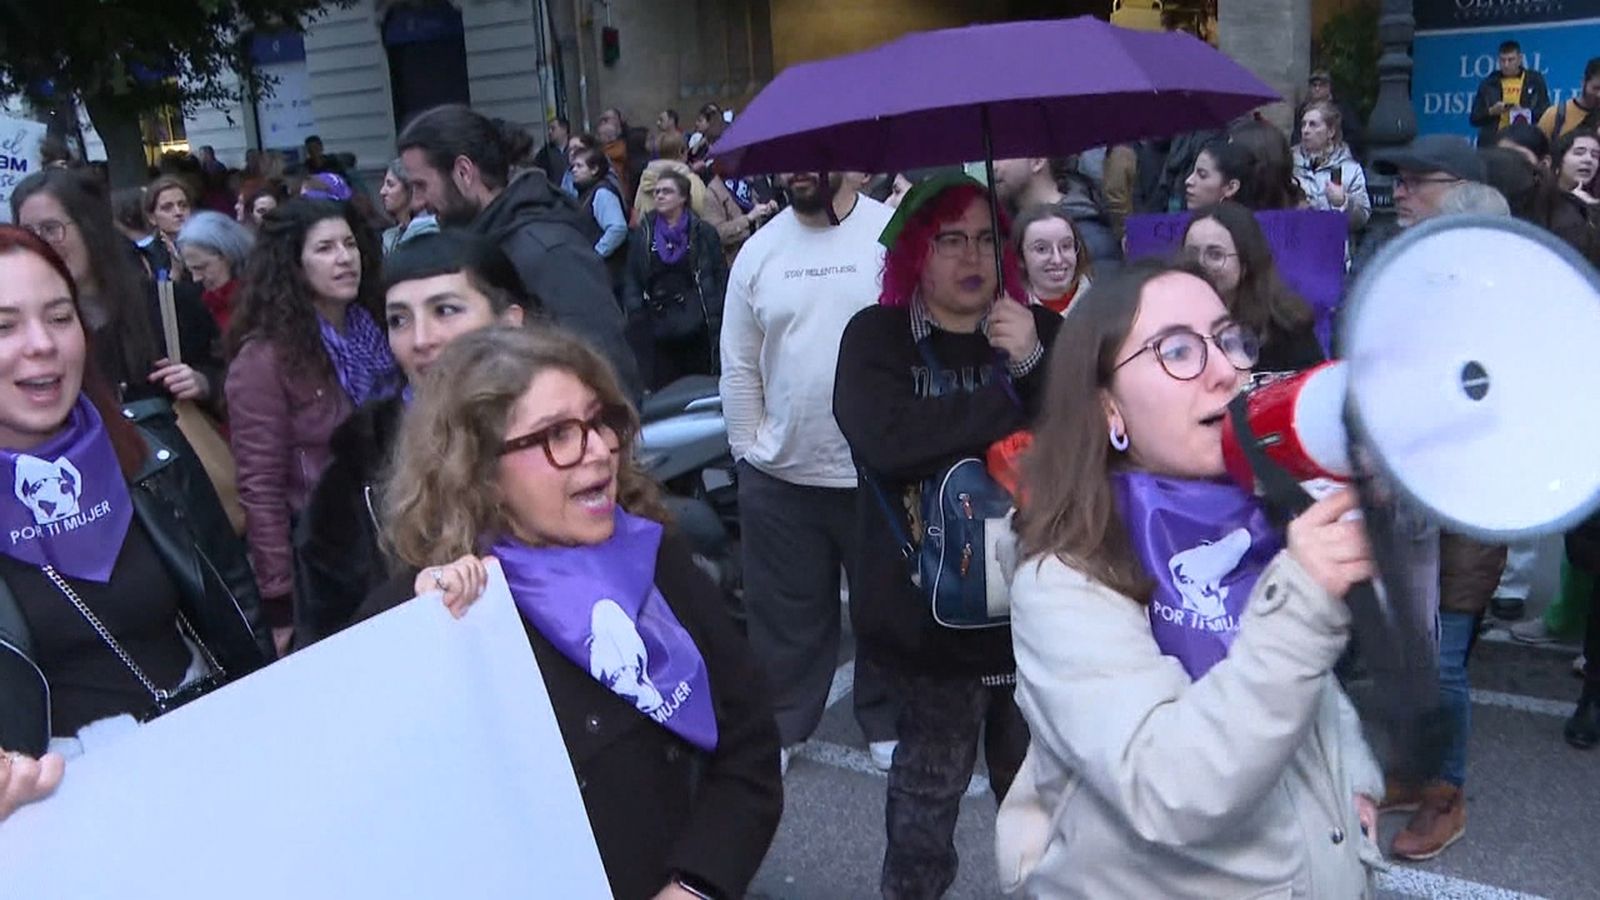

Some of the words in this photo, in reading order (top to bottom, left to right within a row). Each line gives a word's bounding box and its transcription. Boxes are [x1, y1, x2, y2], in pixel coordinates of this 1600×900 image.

[9, 525, 44, 544] POR
[46, 523, 60, 537] TI
[63, 500, 112, 532] MUJER
[1153, 600, 1184, 626] POR
